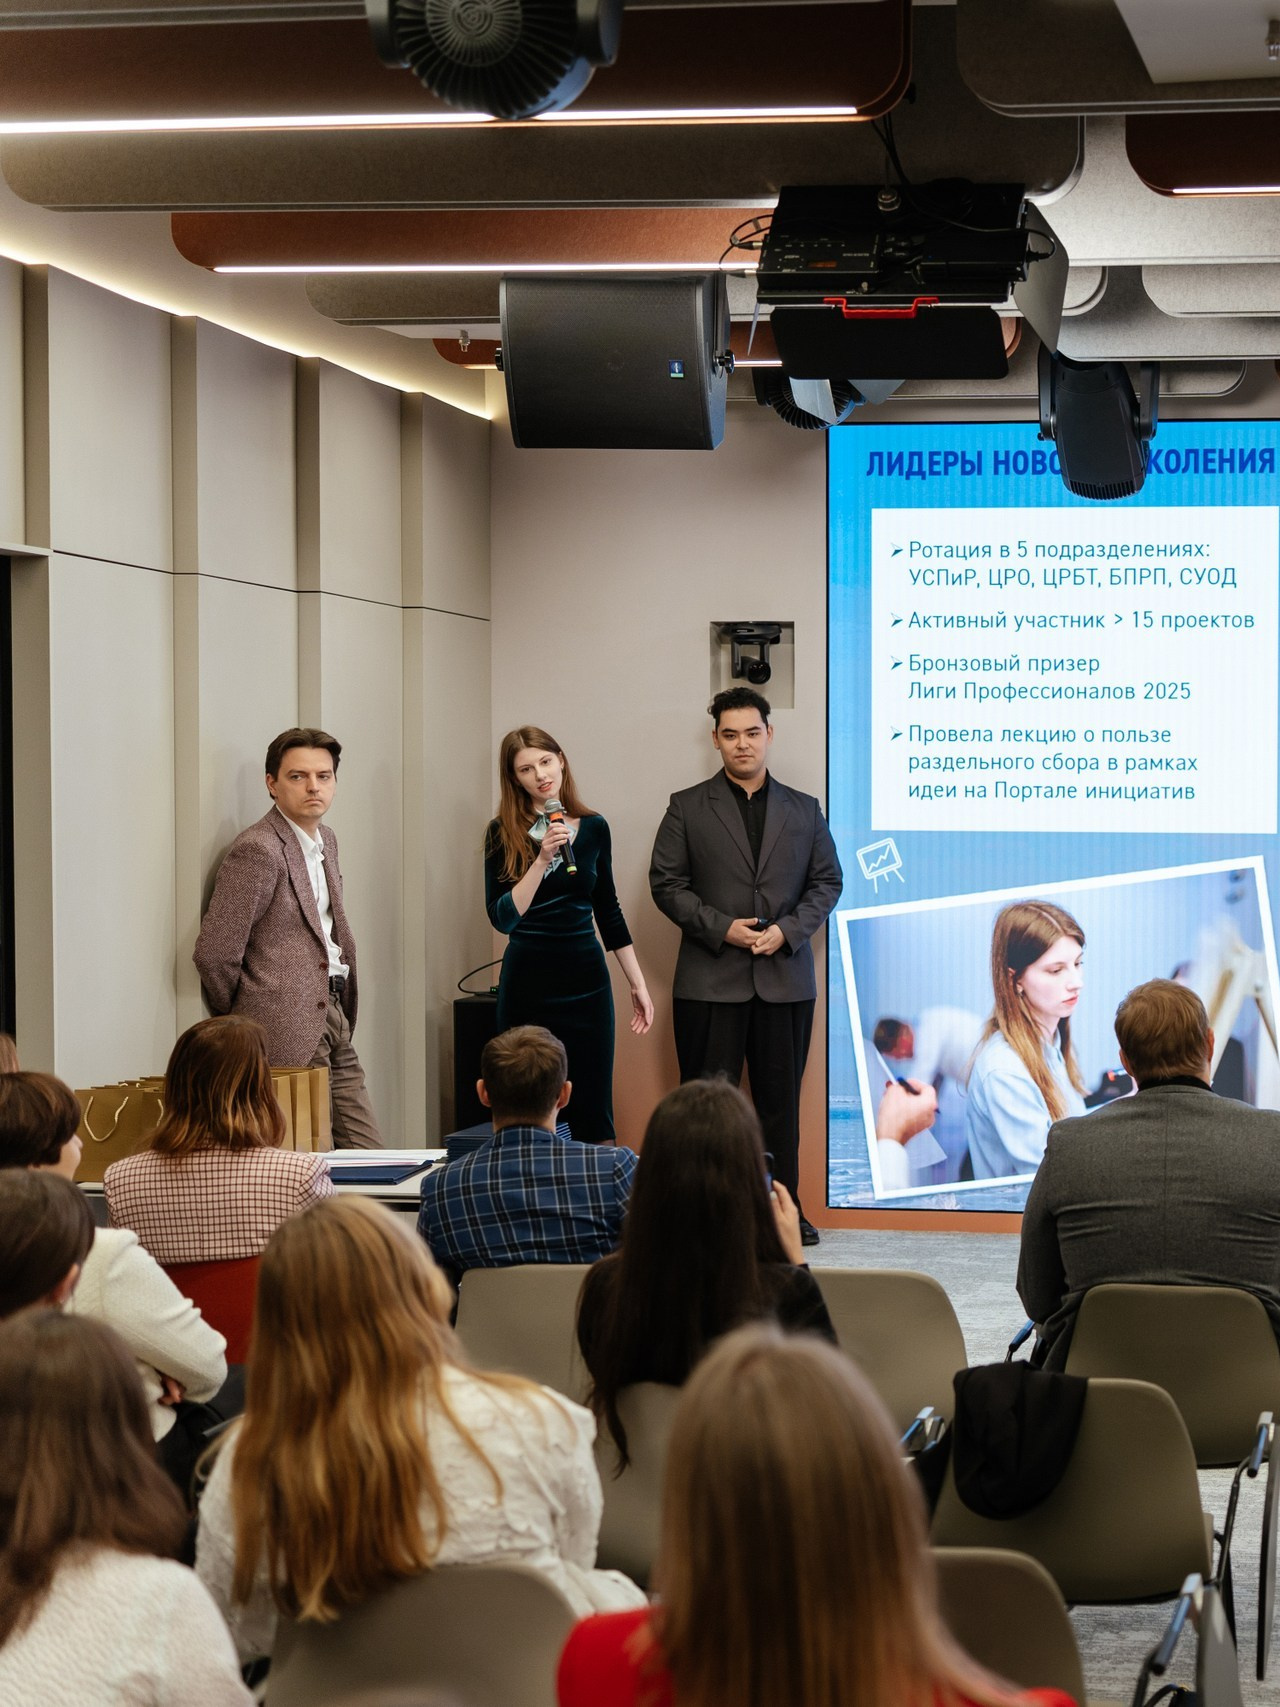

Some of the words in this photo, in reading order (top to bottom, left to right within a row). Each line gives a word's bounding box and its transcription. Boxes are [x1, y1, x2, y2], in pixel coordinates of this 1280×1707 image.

[866, 450, 983, 481] ЛИДЕРЫ
[993, 449, 1064, 476] НОВО
[1145, 447, 1276, 475] КОЛЕНИЯ
[909, 540, 992, 561] Ротация
[999, 544, 1011, 558] в
[1017, 540, 1028, 558] 5
[1035, 543, 1211, 563] подразделениях:
[908, 568, 981, 589] УСПиР,
[988, 568, 1035, 590] ЦРО,
[1043, 568, 1102, 589] ЦРБТ,
[1109, 567, 1172, 589] БПРП,
[1179, 567, 1238, 589] СУОД
[908, 610, 1007, 629] Активный
[1013, 614, 1105, 633] участник
[1132, 610, 1154, 629] 15
[1161, 614, 1255, 633] проектов
[909, 653, 1021, 673] Бронзовый
[1028, 658, 1100, 676] призер
[908, 681, 956, 699] Лиги
[964, 681, 1136, 704] Профессионалов
[1143, 681, 1191, 700] 2025
[909, 724, 993, 743] Провела
[1000, 729, 1077, 746] лекцию
[1083, 729, 1095, 743] о
[1101, 729, 1172, 743] пользе
[908, 754, 1035, 774] раздельного
[1041, 752, 1100, 774] сбора
[1107, 757, 1119, 771] в
[1125, 757, 1198, 775] рамках
[908, 784, 957, 802] идеи
[964, 785, 987, 799] на
[995, 780, 1078, 803] Портале
[1085, 785, 1196, 802] инициатив
